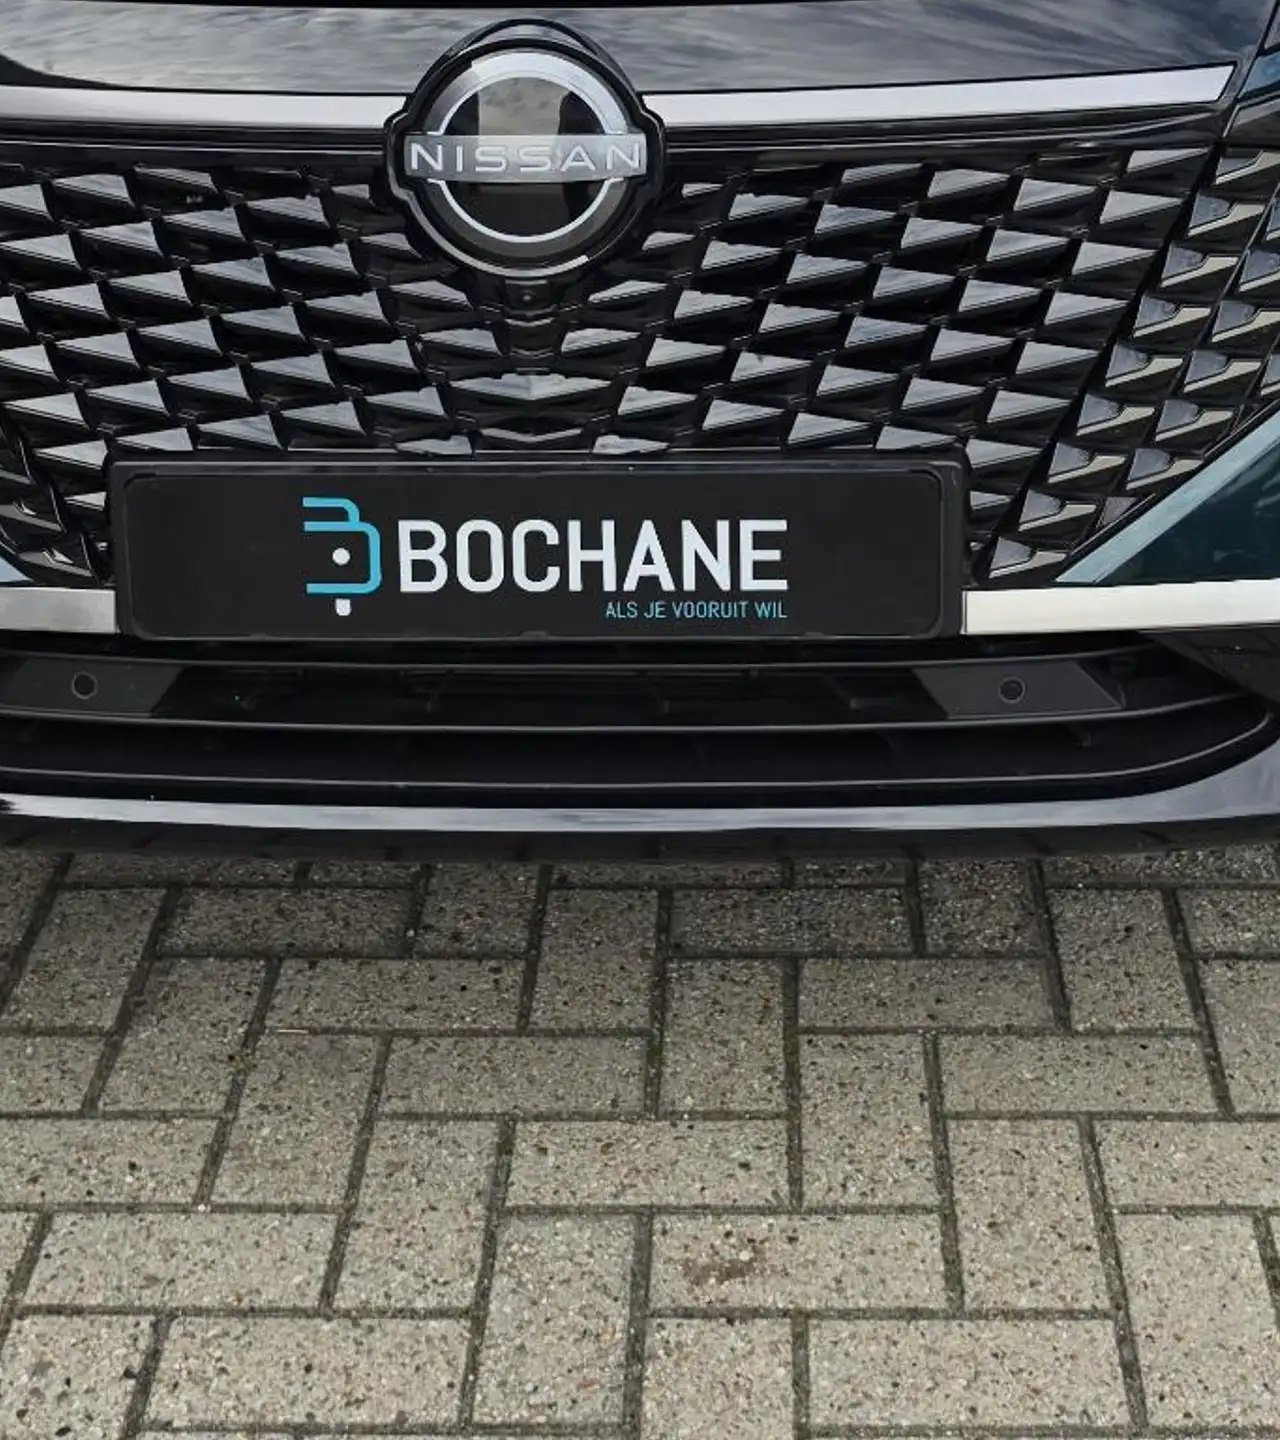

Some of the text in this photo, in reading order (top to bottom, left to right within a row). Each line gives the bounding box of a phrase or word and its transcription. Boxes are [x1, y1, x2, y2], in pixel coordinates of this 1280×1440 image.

[410, 142, 642, 173] NISSAN
[397, 519, 788, 594] BOCHANE
[605, 601, 788, 619] ALS JE VOORUIT WIL
